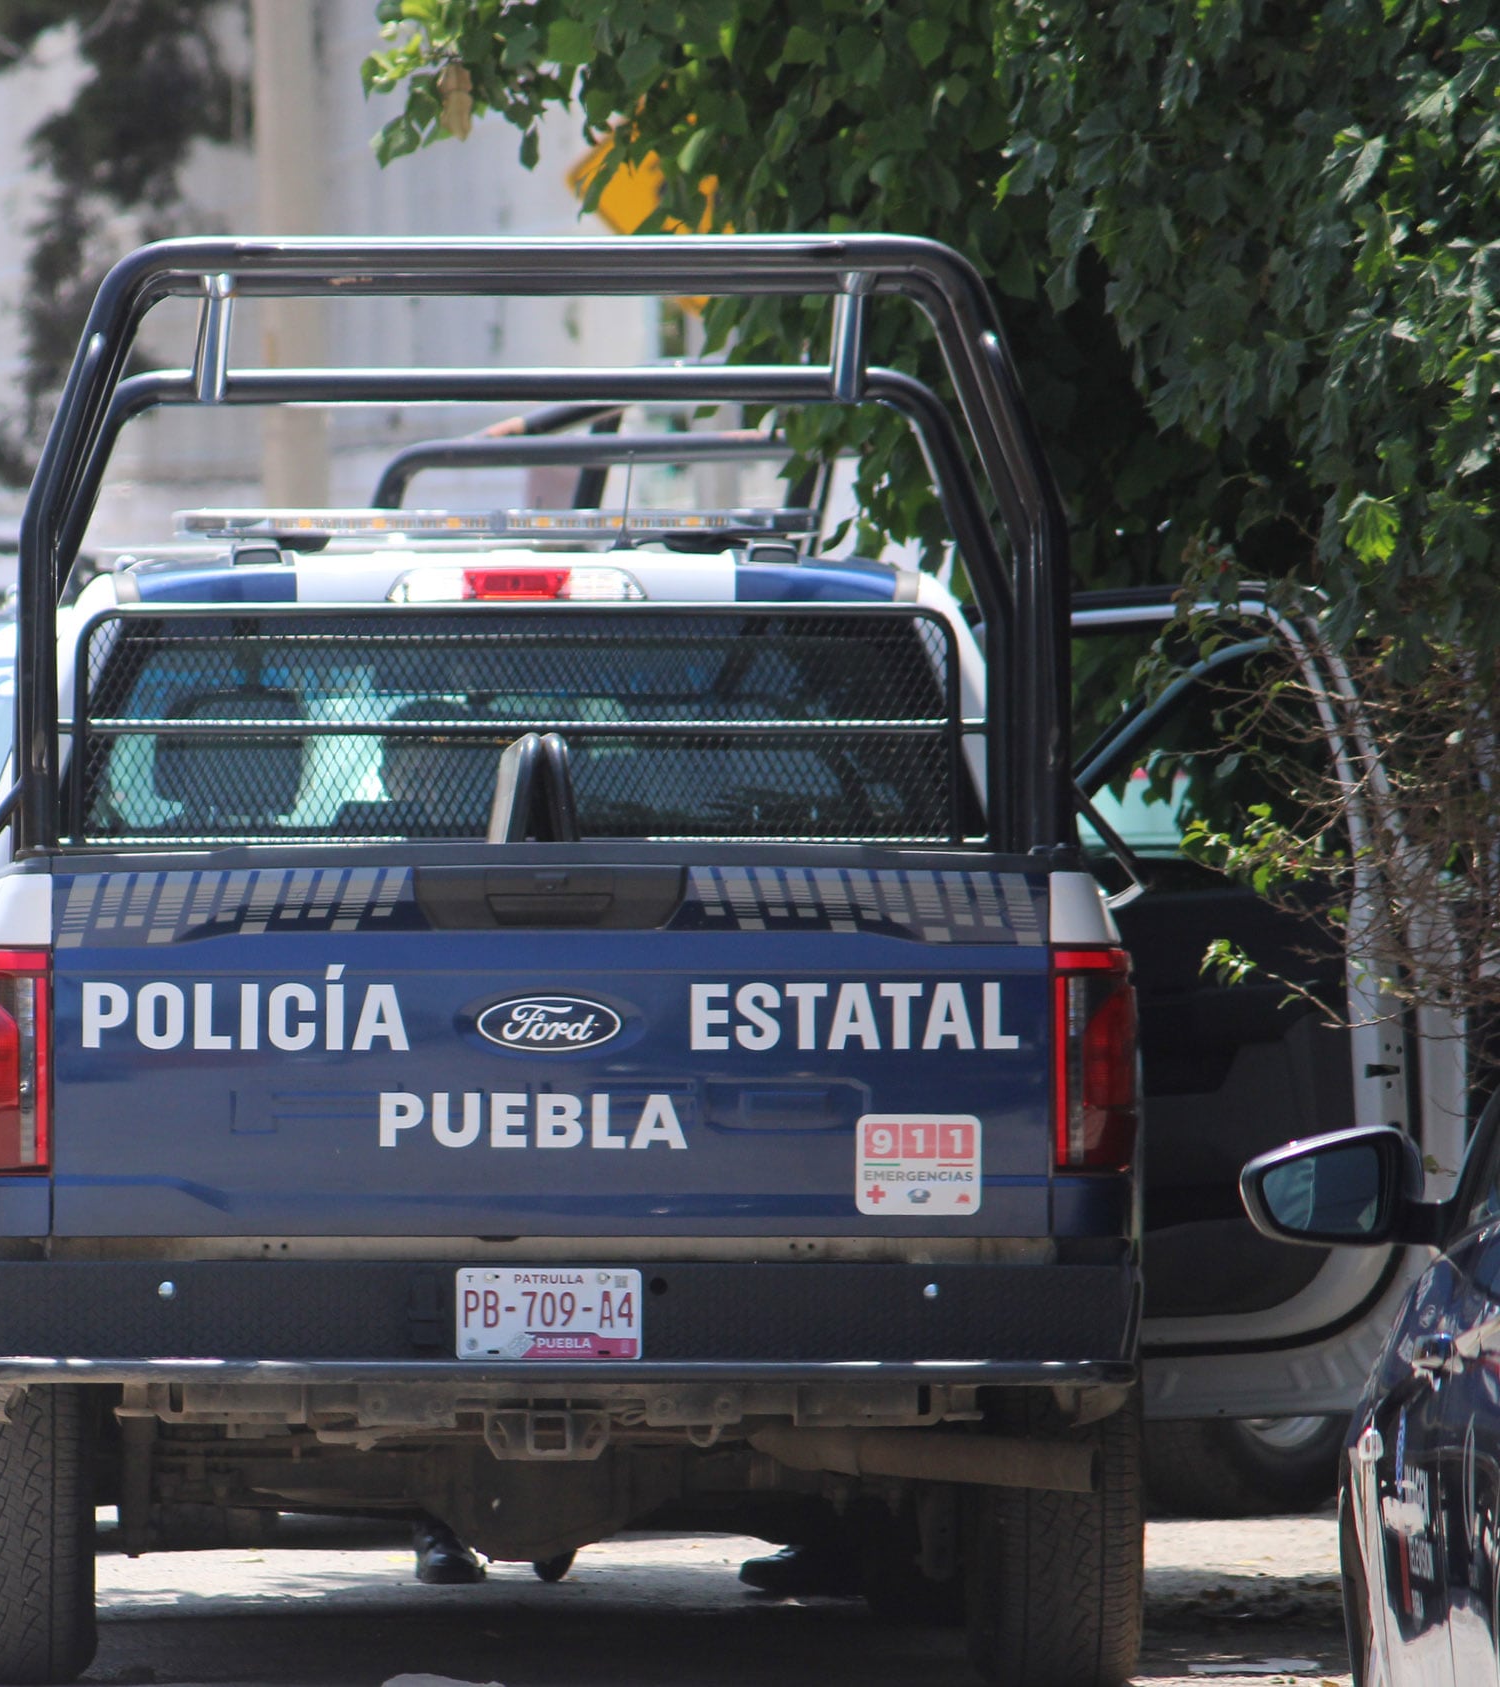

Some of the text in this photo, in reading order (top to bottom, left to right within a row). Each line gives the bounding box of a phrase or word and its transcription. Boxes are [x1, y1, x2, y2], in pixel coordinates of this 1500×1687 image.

[81, 964, 1020, 1051] POLICÍA ESTATAL
[501, 1004, 594, 1042] Ford
[379, 1092, 688, 1150] PUEBLA
[871, 1128, 964, 1155] 911
[864, 1170, 973, 1182] EMERGENCIAS
[514, 1273, 585, 1285] PATRULLA
[463, 1289, 633, 1328] PB-709-A4
[536, 1337, 593, 1349] PUEBLA
